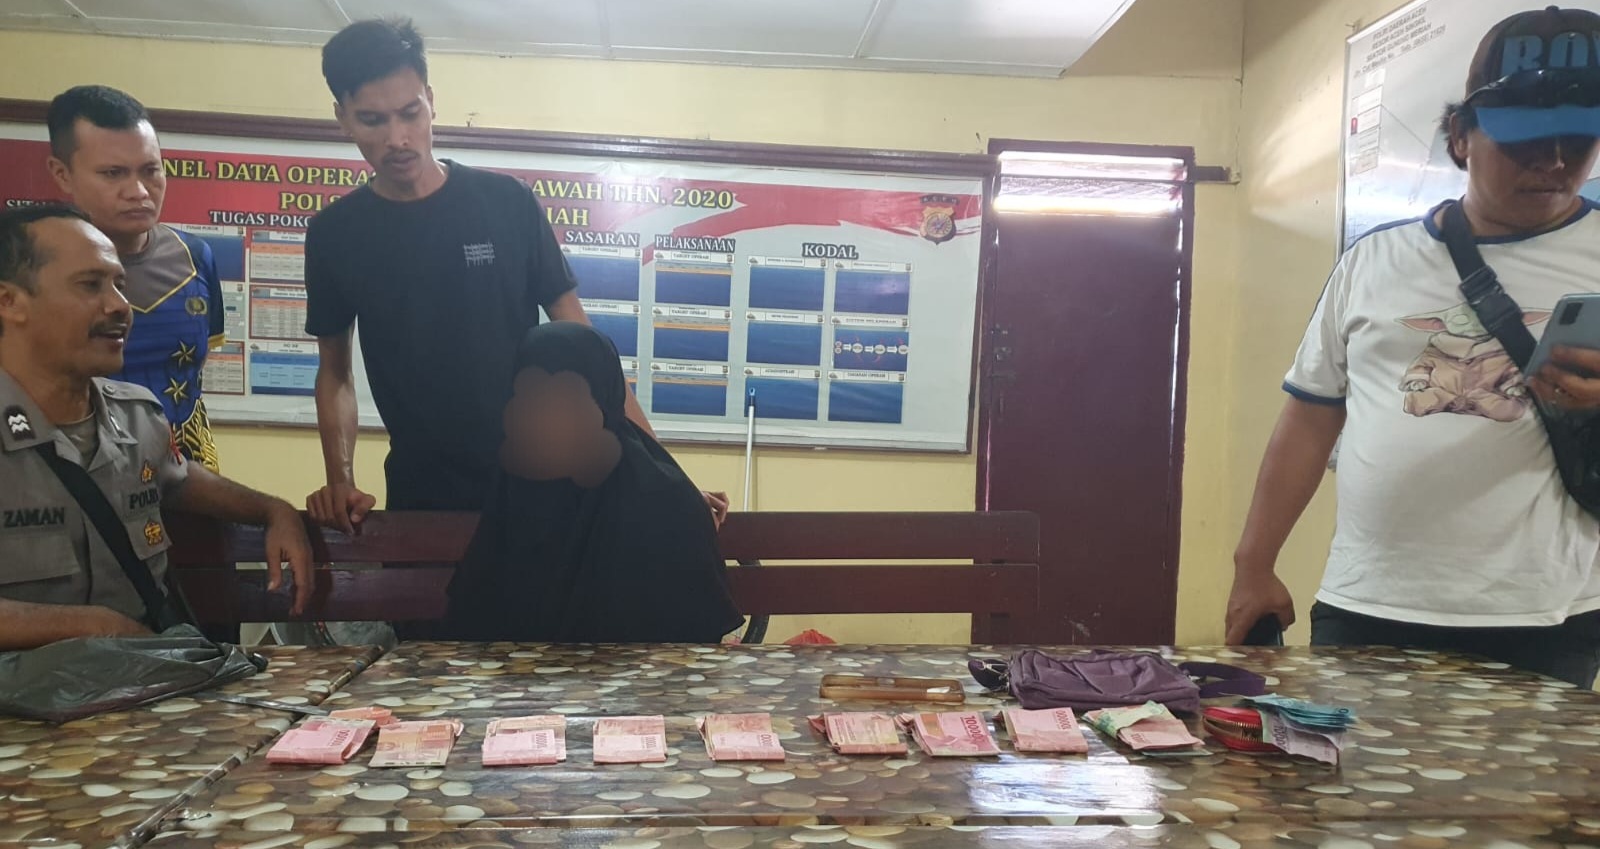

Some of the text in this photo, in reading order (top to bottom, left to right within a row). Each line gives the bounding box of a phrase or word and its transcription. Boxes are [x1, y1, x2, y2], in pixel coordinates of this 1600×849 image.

[163, 158, 733, 210] NEL DATA OPERA AWAH THN. 2020
[209, 210, 265, 226] TUGAS
[547, 207, 588, 226] IAH
[566, 230, 639, 247] SASARAN
[655, 235, 735, 253] PELAKSANAAN
[803, 243, 858, 259] KODAL
[4, 506, 66, 528] ZAMAN
